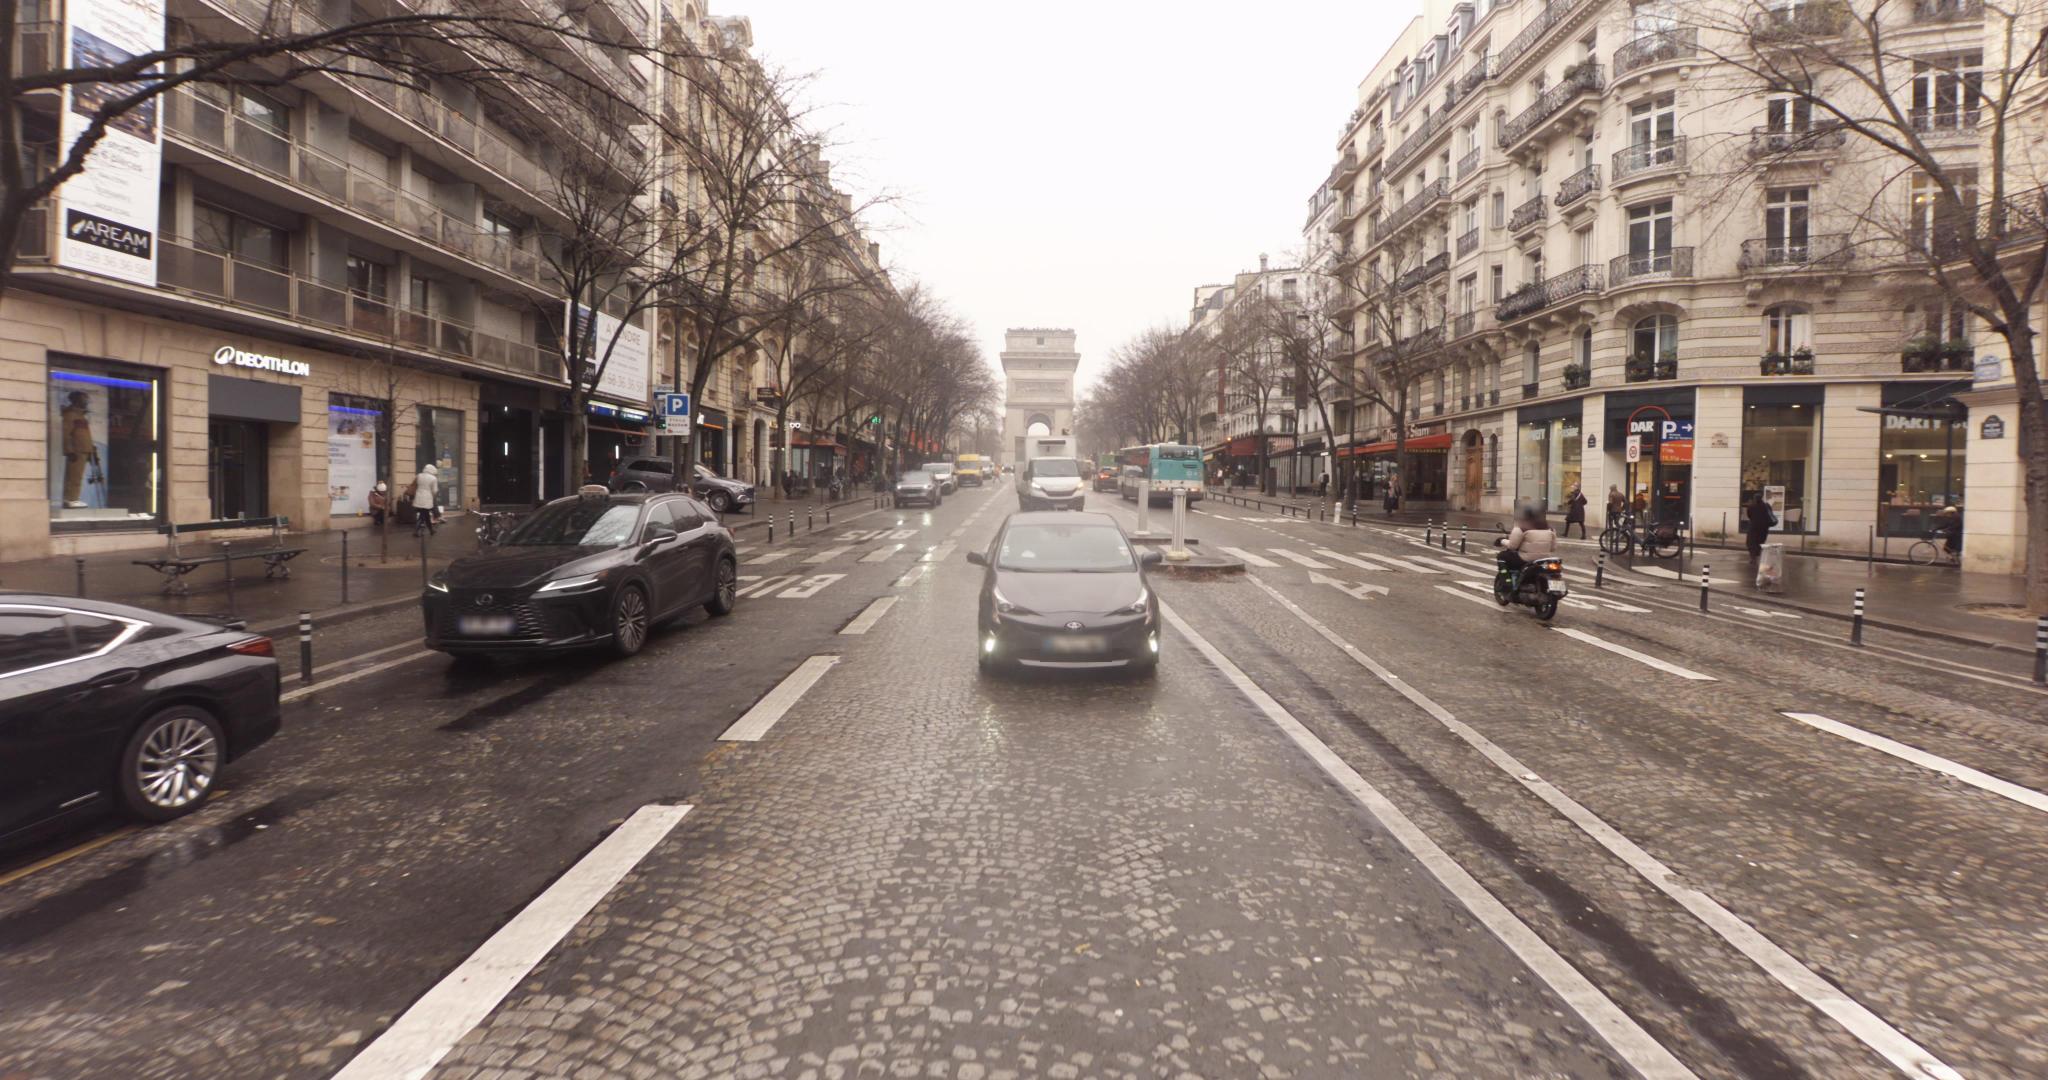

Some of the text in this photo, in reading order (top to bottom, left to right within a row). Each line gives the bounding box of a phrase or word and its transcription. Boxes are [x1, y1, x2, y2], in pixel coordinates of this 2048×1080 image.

[83, 220, 148, 249] AREAM
[235, 351, 310, 377] DECATHLON
[672, 398, 683, 413] P
[1662, 420, 1677, 440] P
